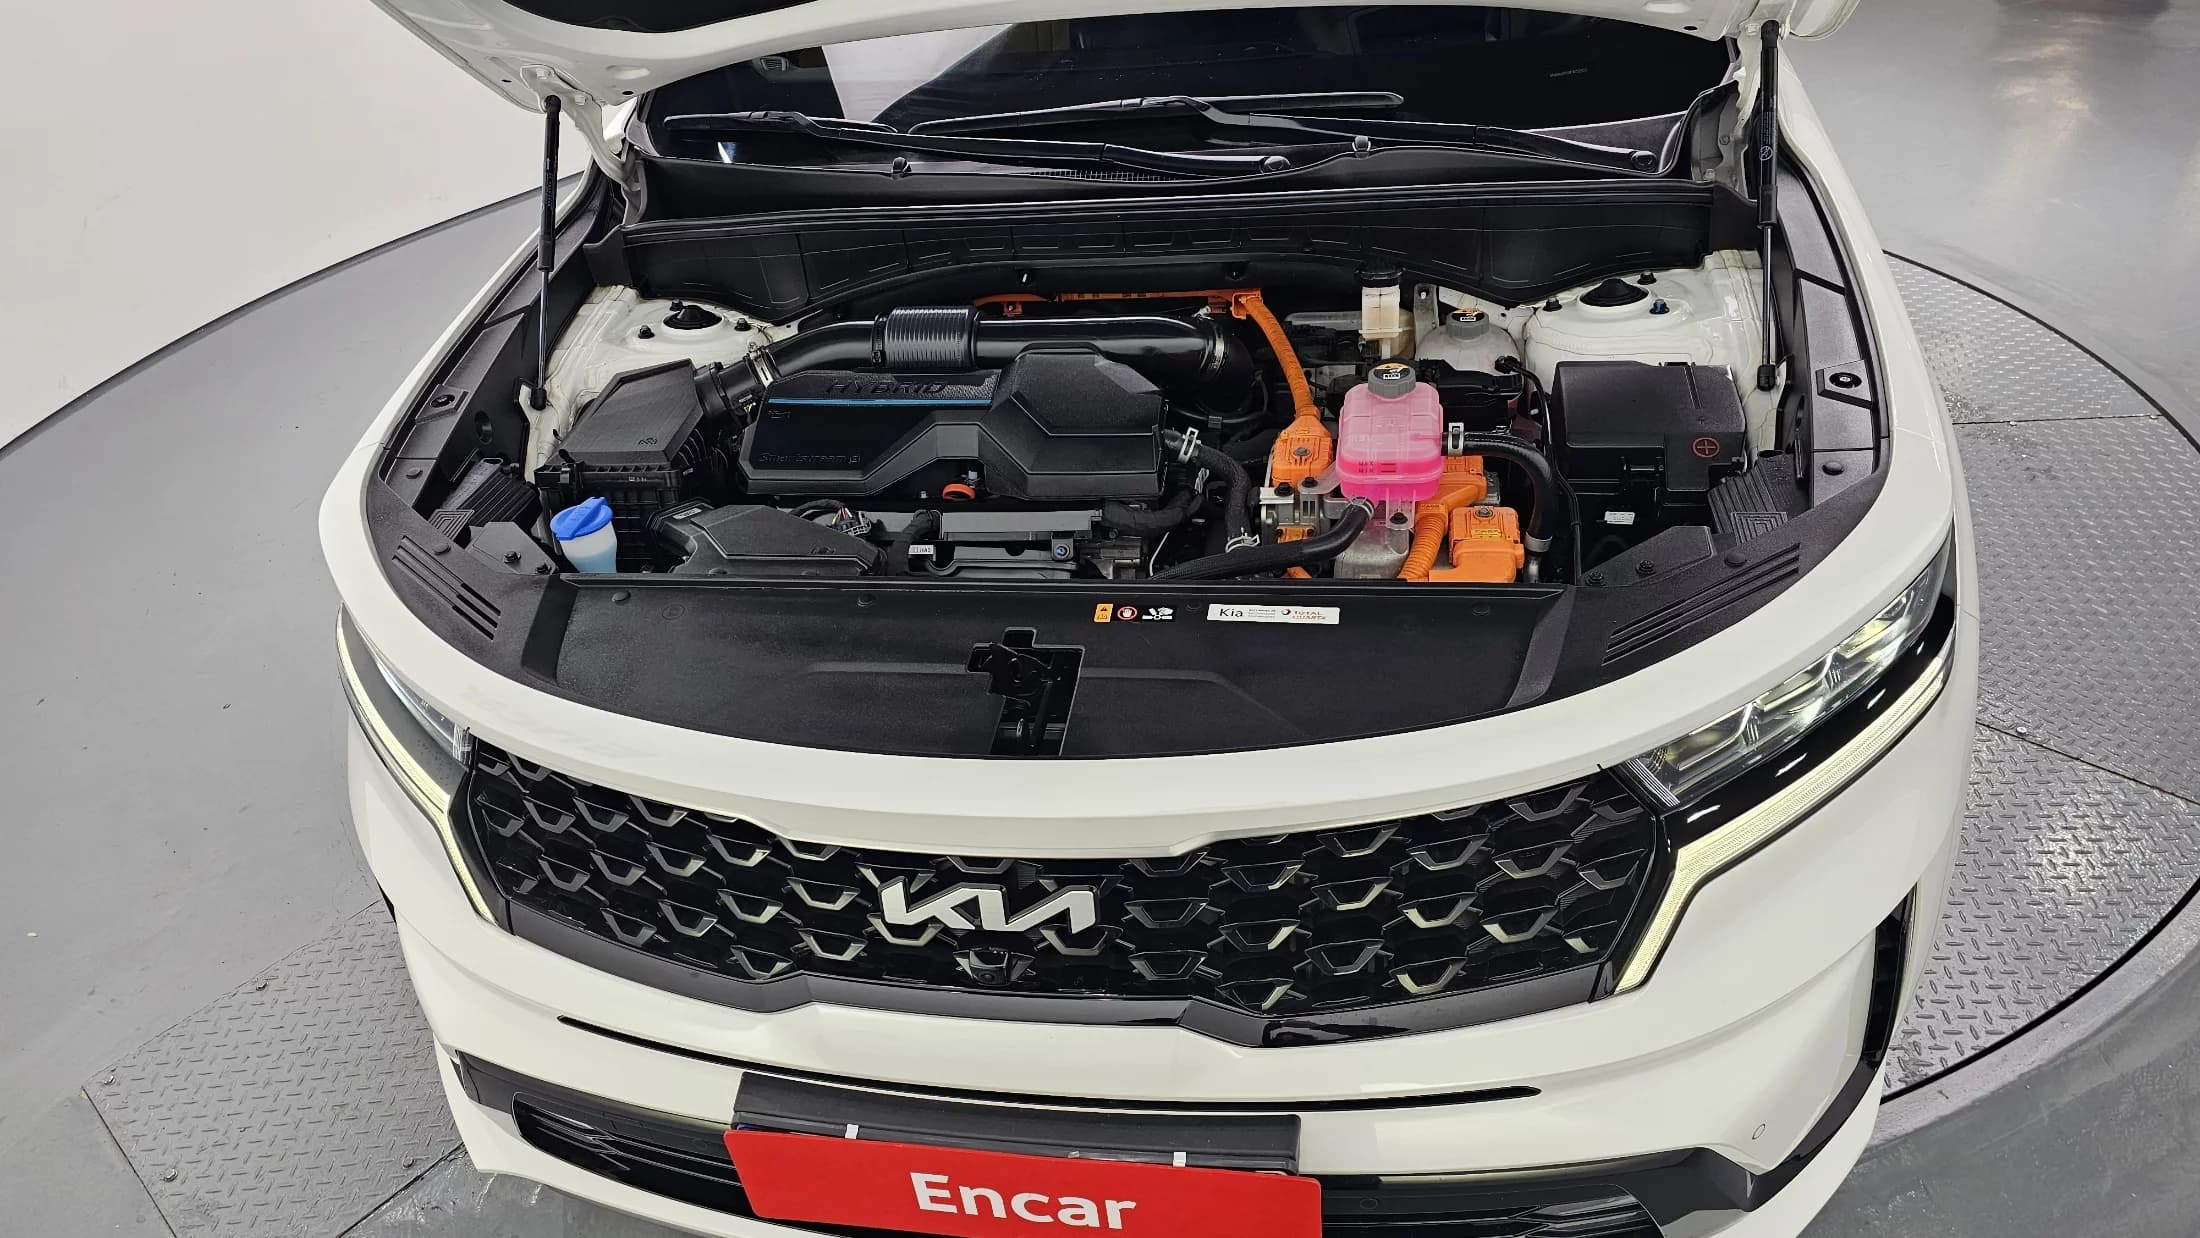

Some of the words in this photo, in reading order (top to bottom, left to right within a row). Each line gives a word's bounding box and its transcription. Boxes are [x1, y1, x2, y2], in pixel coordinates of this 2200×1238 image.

[826, 379, 946, 394] HYBRID
[1219, 608, 1244, 617] Kia
[880, 880, 1096, 934] KIA
[909, 1170, 1137, 1231] Encar
